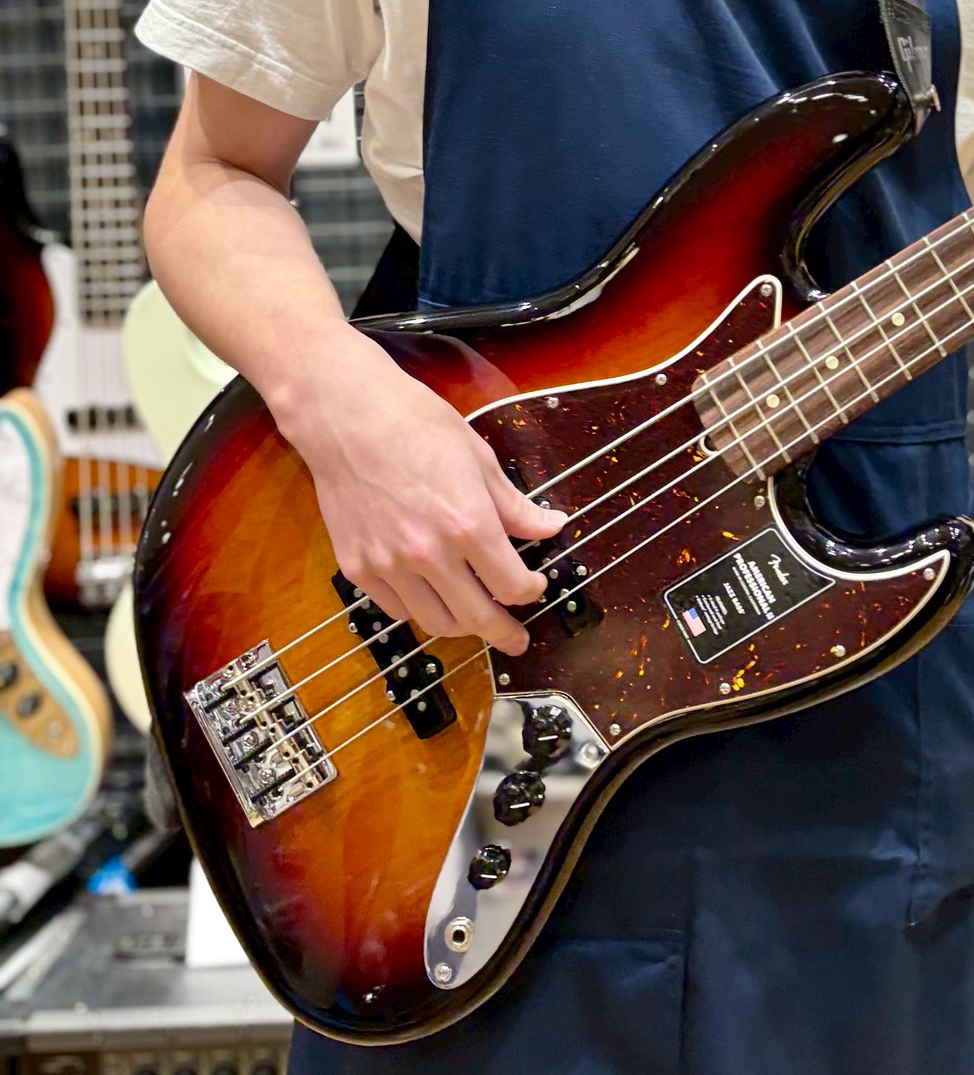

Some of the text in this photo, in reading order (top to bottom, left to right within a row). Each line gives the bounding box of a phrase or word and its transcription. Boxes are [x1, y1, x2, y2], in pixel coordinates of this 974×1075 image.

[733, 553, 771, 613] PROFESSIONAL
[748, 561, 776, 604] AMERICAN
[768, 553, 789, 586] Fender
[723, 582, 736, 598] JAZZ
